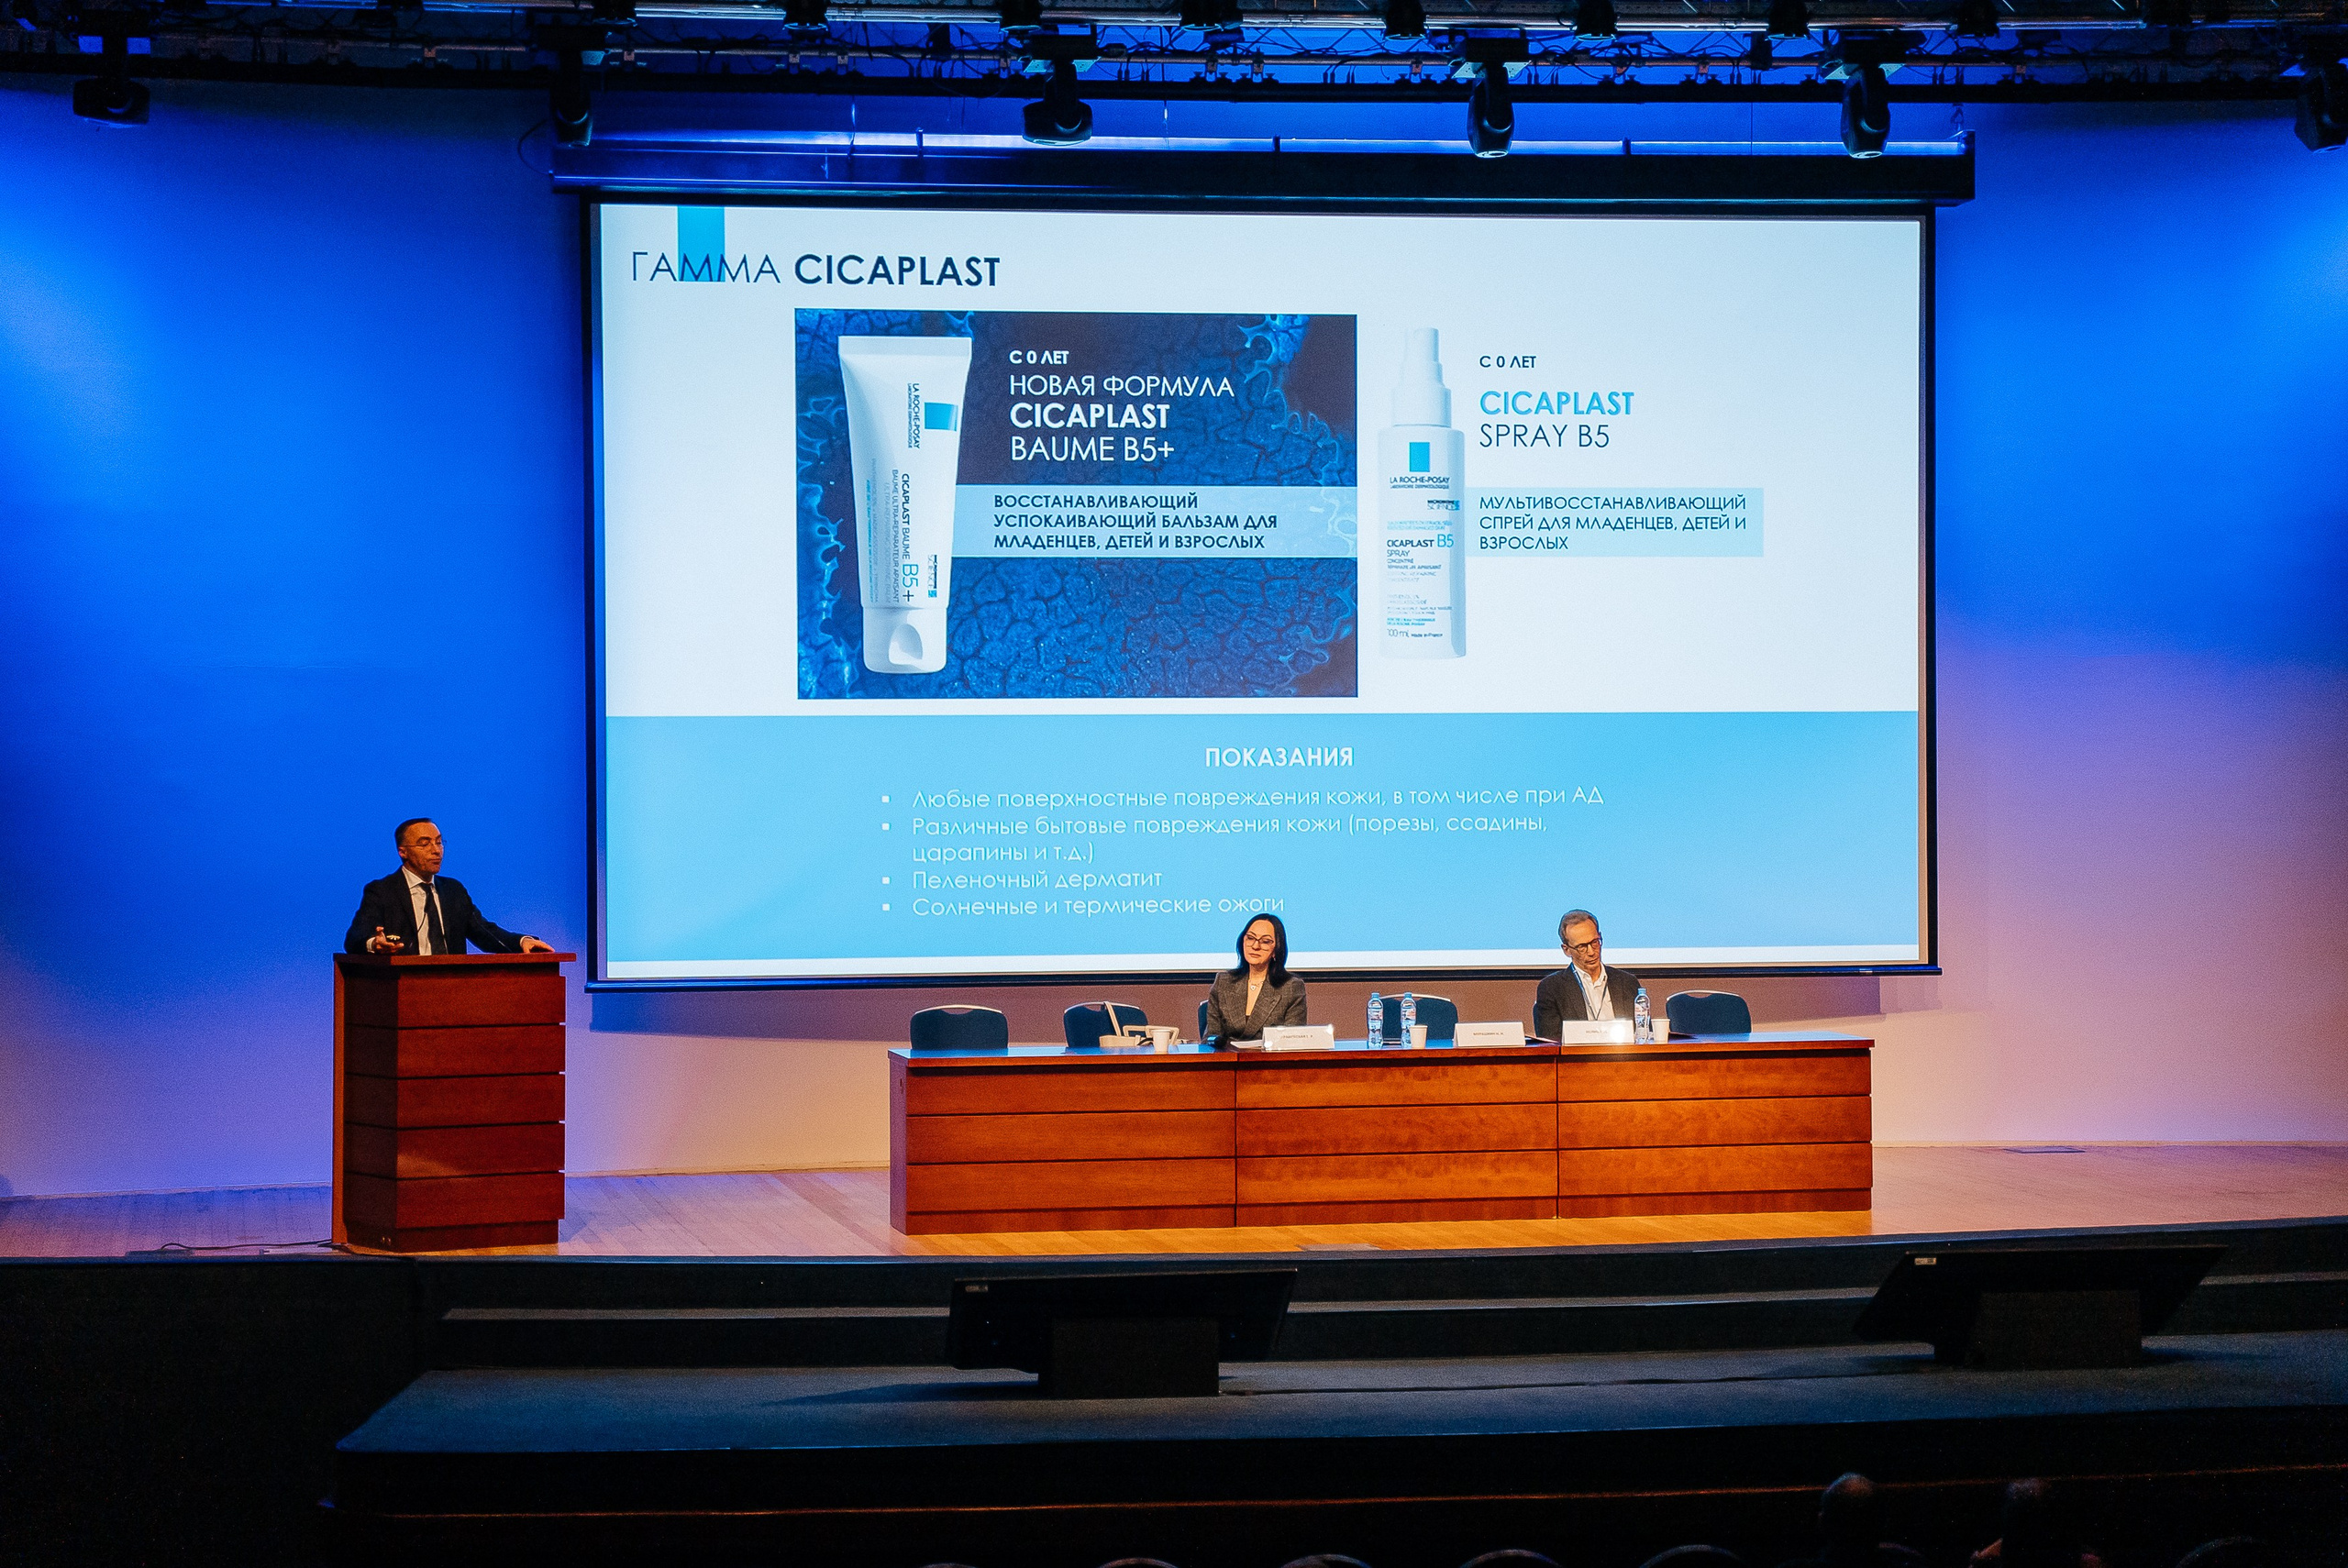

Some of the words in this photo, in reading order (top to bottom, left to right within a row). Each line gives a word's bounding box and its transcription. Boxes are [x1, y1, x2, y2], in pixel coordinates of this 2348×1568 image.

[632, 248, 781, 283] ГАММА
[794, 253, 1001, 287] CICAPLAST
[1040, 349, 1069, 365] ЛЕТ
[1510, 355, 1537, 369] ЛЕТ
[1010, 374, 1095, 396] НОВАЯ
[1102, 375, 1235, 397] ФОРМУЛА
[1479, 390, 1635, 416] CICAPLAST
[1010, 402, 1170, 429] CICAPLAST
[1479, 423, 1568, 447] SPRAY
[1578, 424, 1610, 448] B5
[1012, 436, 1114, 462] BAUME
[1124, 436, 1175, 462] B5+
[994, 491, 1198, 511] ВОССТАНАВЛИВАЮЩИЙ
[1479, 493, 1746, 512] МУЛЬТИВОССТАНАВЛИВАЮЩИЙ
[993, 511, 1157, 530] УСПОКАИВАЮЩИЙ
[1162, 514, 1239, 528] БАЛЬЗАМ
[1243, 514, 1278, 531] ДЛЯ
[1479, 513, 1534, 530] СПРЕЙ
[1537, 516, 1571, 532] ДЛЯ
[1576, 516, 1678, 532] МЛАДЕНЦЕВ,
[1681, 513, 1730, 532] ДЕТЕЙ
[1734, 516, 1746, 530] И
[993, 535, 1101, 550] МЛАДЕНЦЕВ,
[1104, 531, 1153, 550] ДЕТЕЙ
[1158, 535, 1169, 548] И
[1174, 535, 1265, 548] ВЗРОСЛЫХ
[1437, 534, 1454, 547] B5
[1479, 536, 1568, 550] ВЗРОСЛЫХ
[1204, 745, 1355, 768] ПОКАЗАНИЯ
[911, 789, 992, 808] Любые
[996, 791, 1169, 812] поверхностные
[1174, 790, 1322, 810] повреждения
[1325, 790, 1388, 807] кожи,
[1392, 790, 1404, 805] в
[1409, 790, 1452, 804] том
[1455, 790, 1520, 805] числе
[1525, 789, 1567, 808] при
[1571, 785, 1605, 805] АД
[913, 817, 1030, 835] Различные
[1034, 815, 1128, 835] бытовые
[1134, 818, 1281, 837] повреждения
[1287, 818, 1342, 834] кожи
[1349, 813, 1441, 836] (порезы,
[1446, 817, 1548, 833] ссадины,
[913, 846, 1028, 866] царапины
[1034, 845, 1048, 861] и
[913, 869, 1049, 890] Пеленочный
[1053, 872, 1163, 891] дерматит
[912, 898, 1039, 916] Солнечные
[1045, 900, 1058, 914] и
[1063, 899, 1212, 918] термические
[1218, 898, 1284, 912] ожоги
